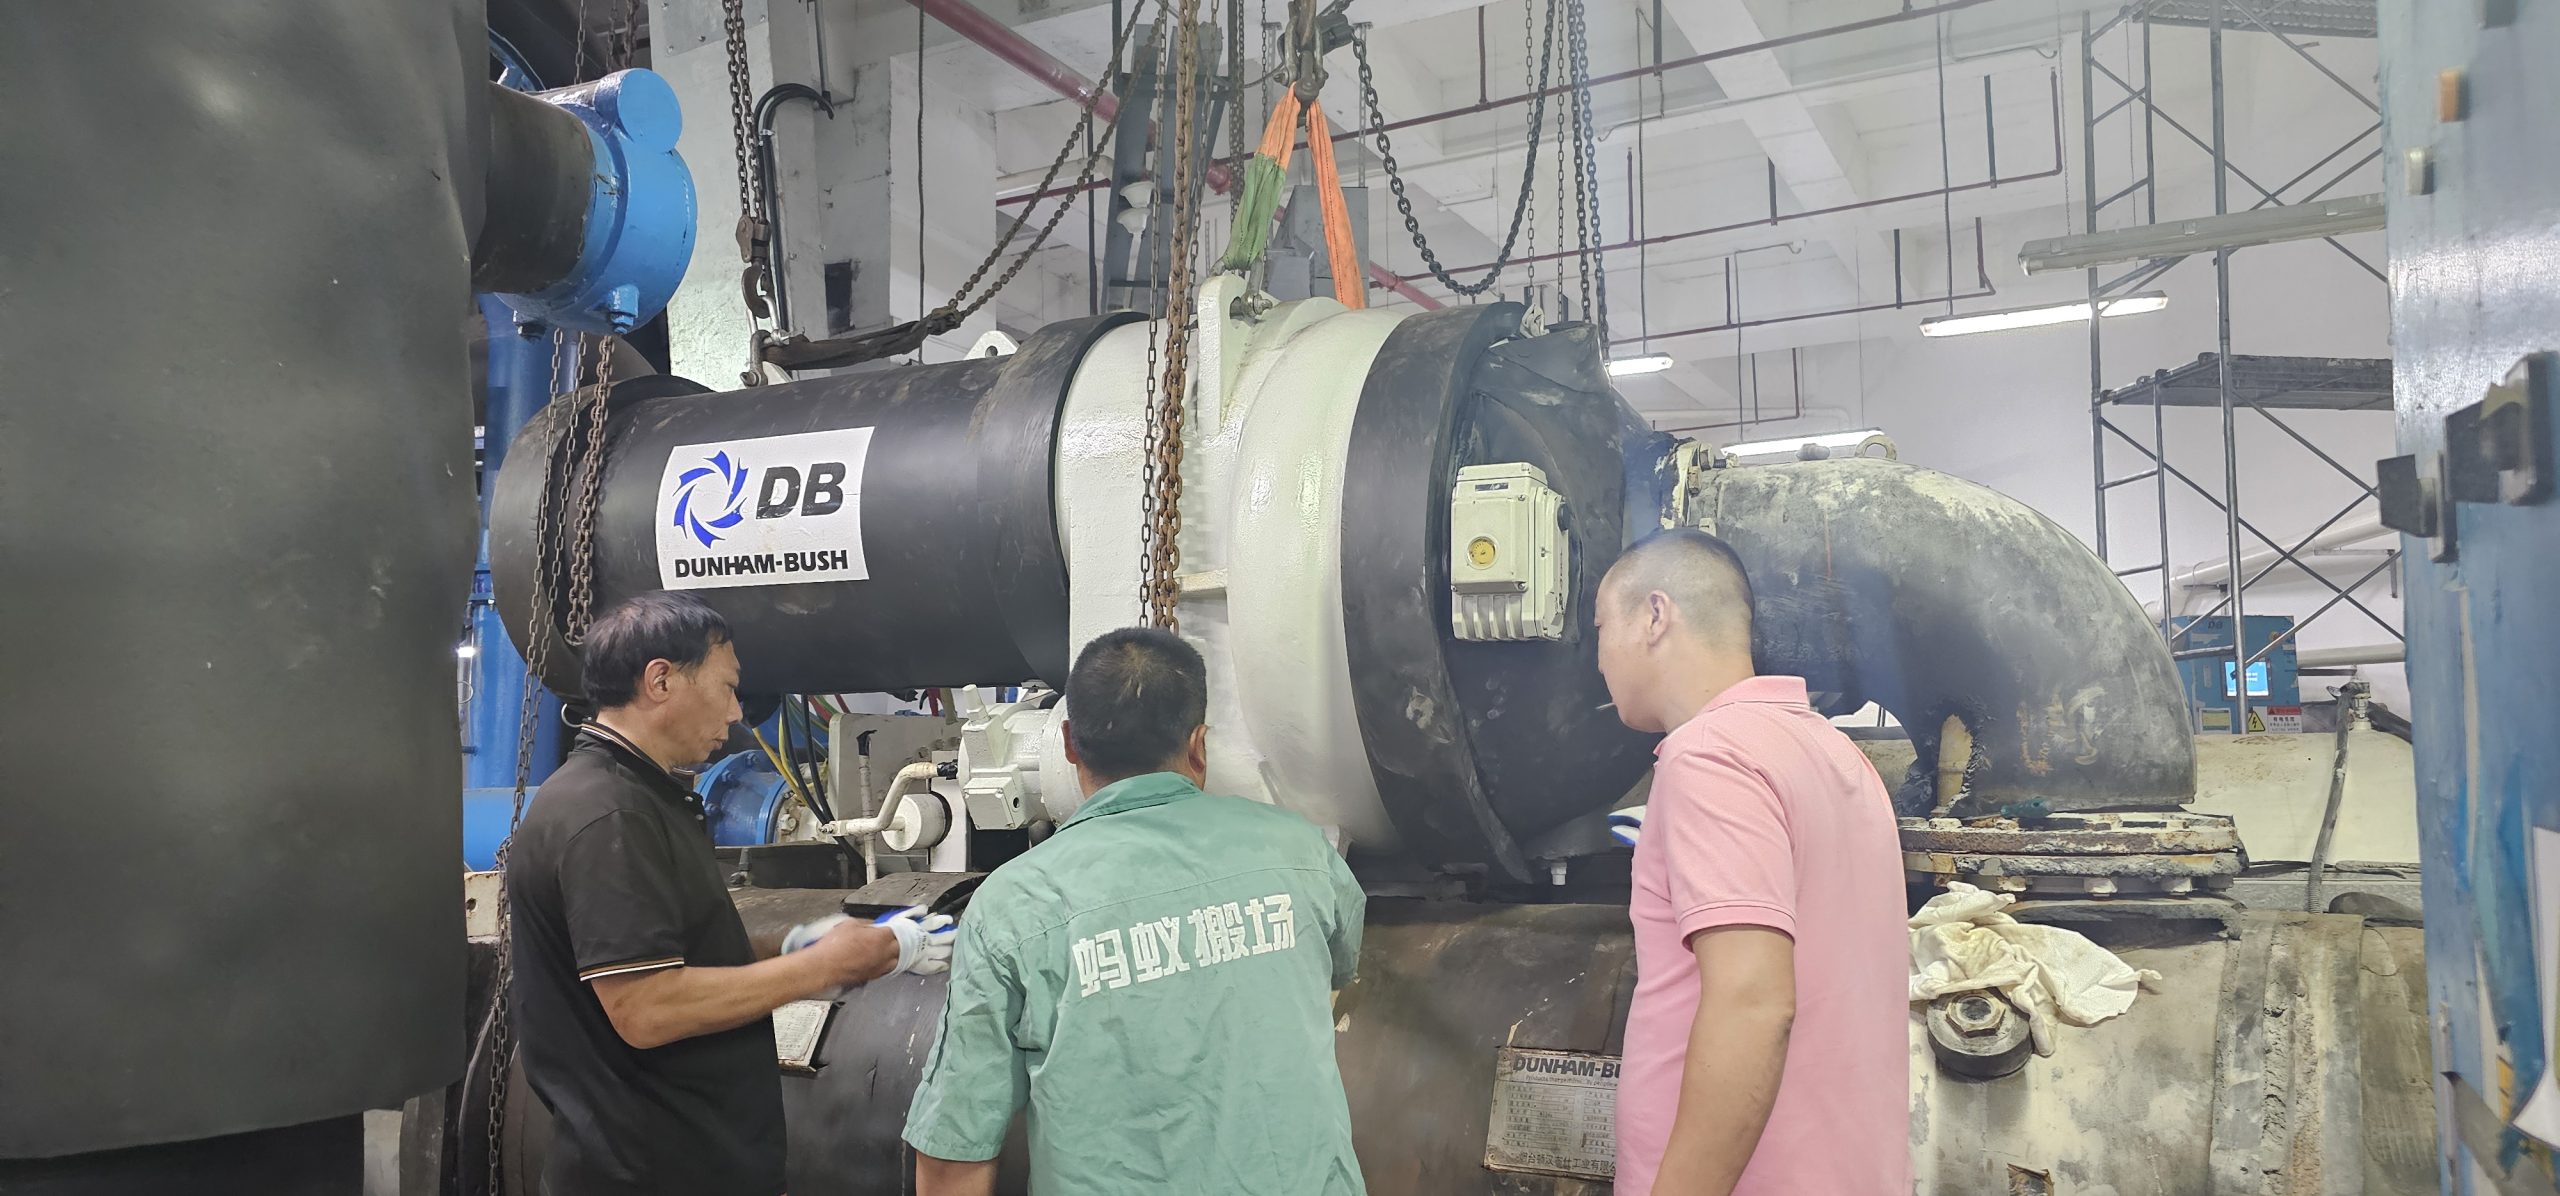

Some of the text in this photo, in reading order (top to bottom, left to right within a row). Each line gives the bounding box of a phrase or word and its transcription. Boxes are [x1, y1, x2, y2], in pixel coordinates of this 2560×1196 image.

[756, 462, 846, 519] DB
[674, 550, 848, 578] DUNHAM-BUSH
[1072, 893, 1296, 998] 蚂蚁搬场
